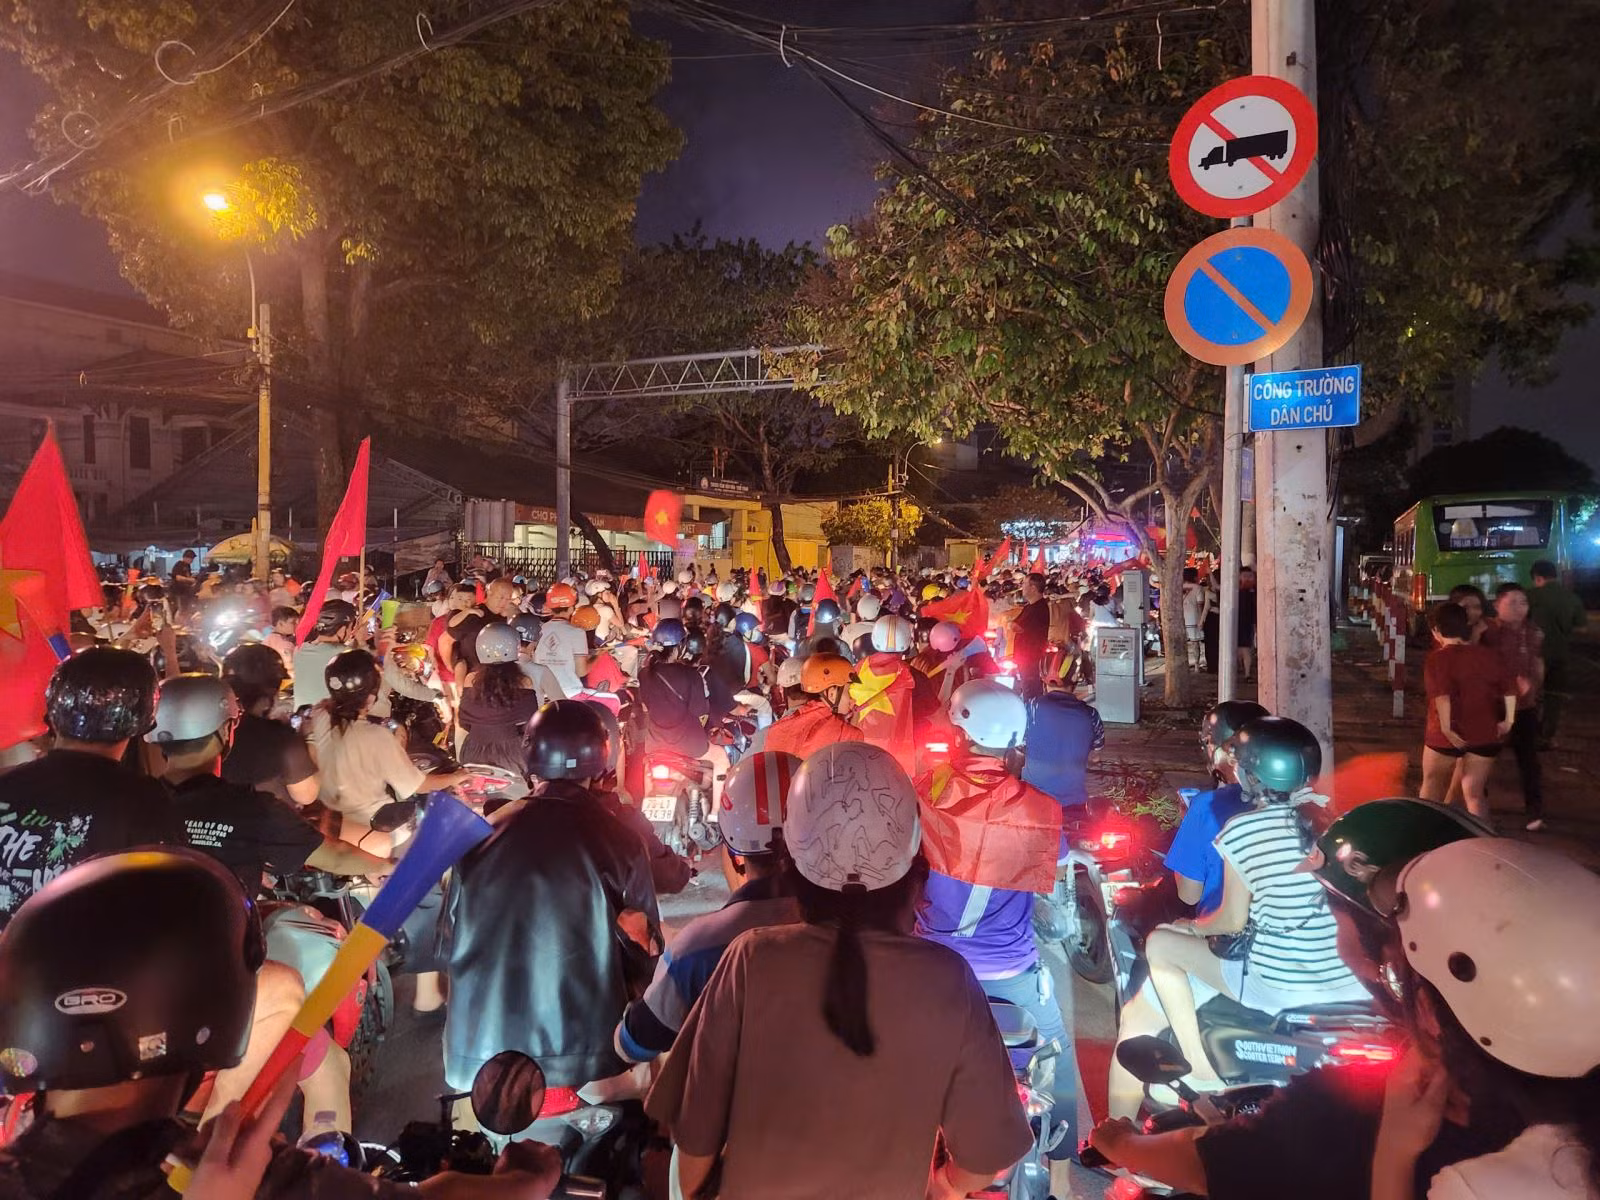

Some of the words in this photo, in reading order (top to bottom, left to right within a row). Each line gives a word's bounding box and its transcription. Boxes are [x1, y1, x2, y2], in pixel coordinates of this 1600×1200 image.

[1253, 379, 1293, 401] CÔNG
[1296, 373, 1355, 397] TRƯỜNG
[1270, 405, 1300, 426] DÂN
[1303, 398, 1333, 423] CHỦ
[204, 821, 216, 830] OF
[216, 823, 234, 833] GOD
